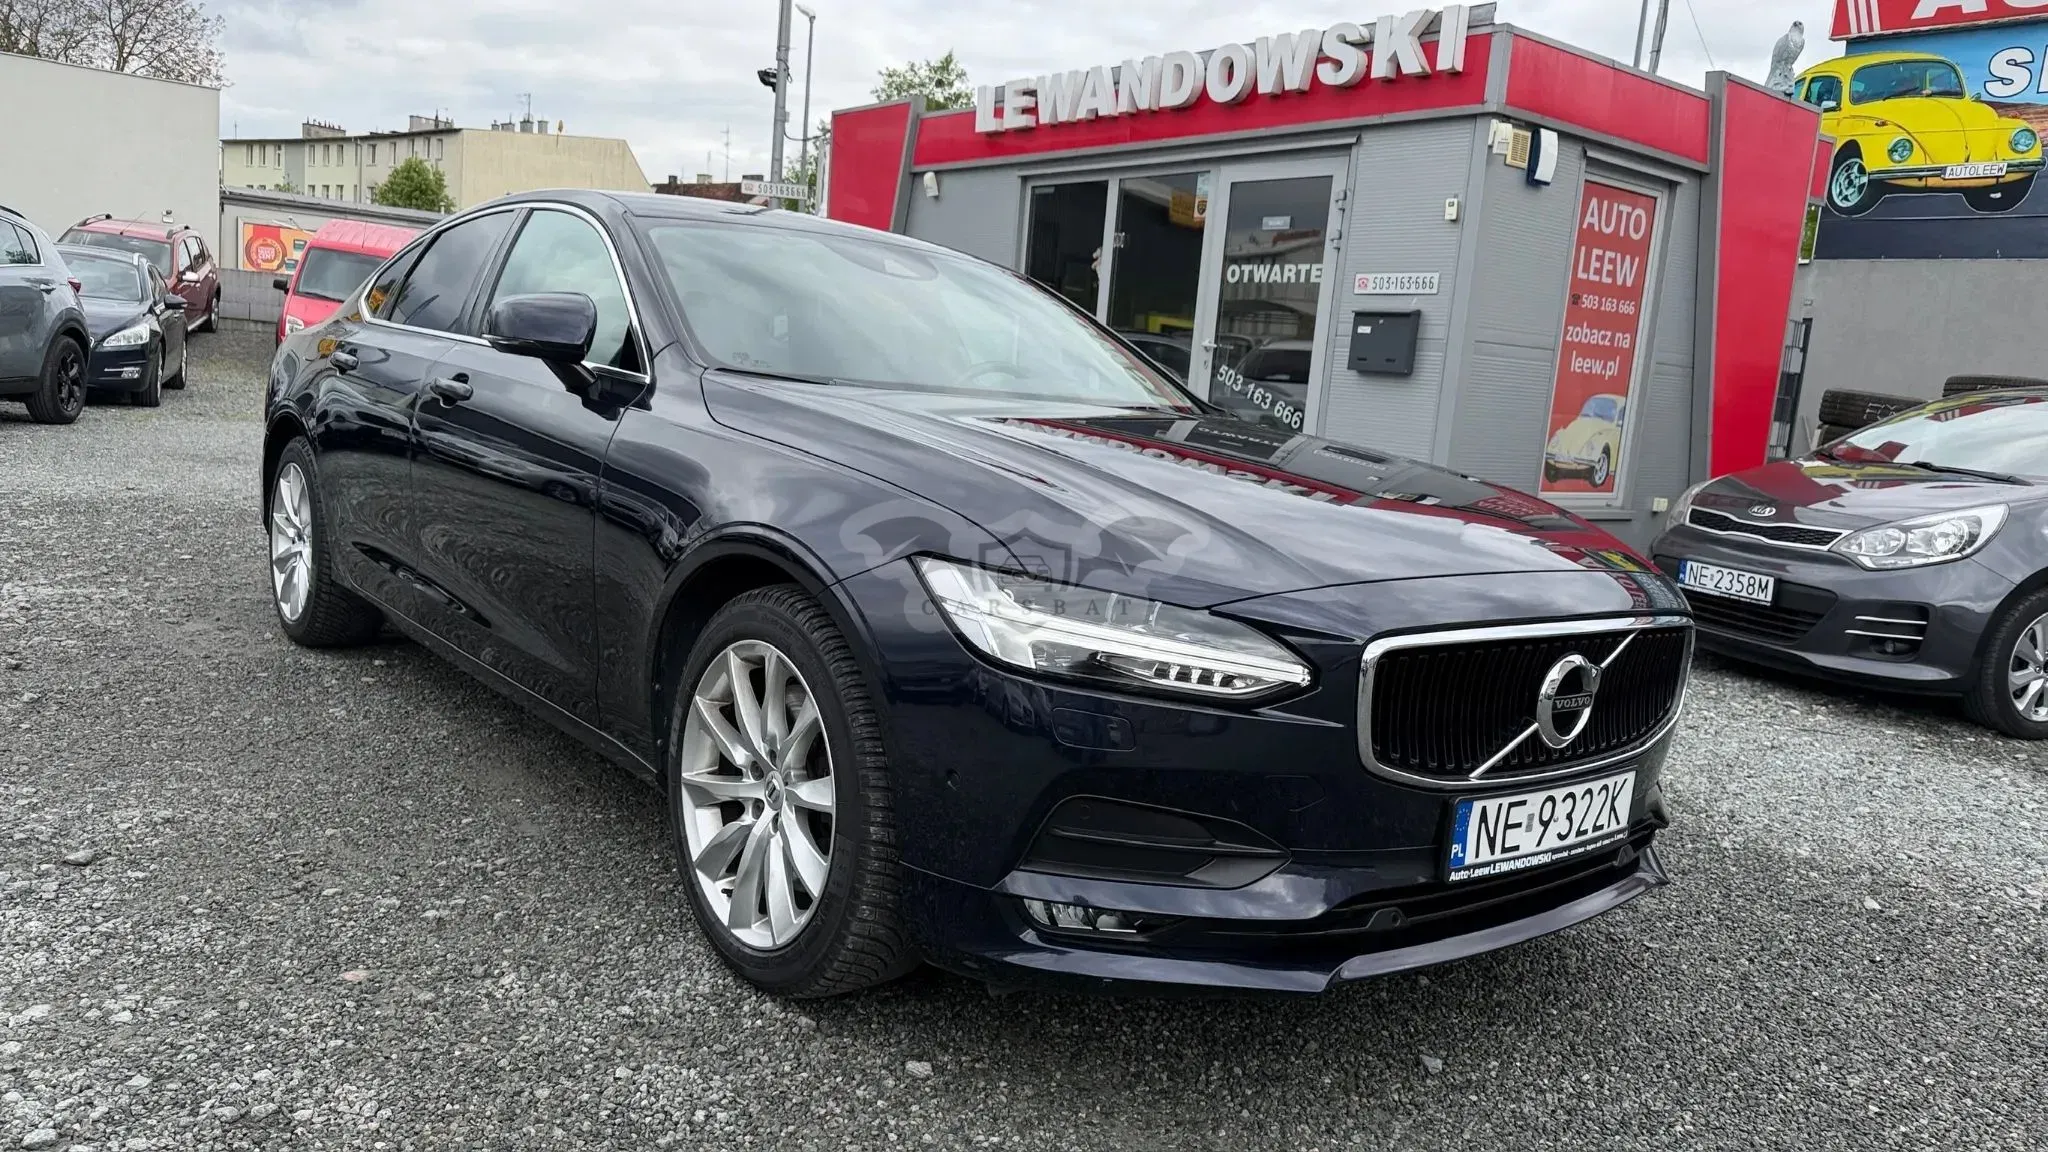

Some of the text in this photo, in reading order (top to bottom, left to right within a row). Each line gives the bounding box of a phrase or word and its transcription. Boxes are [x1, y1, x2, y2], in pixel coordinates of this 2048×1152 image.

[975, 4, 1467, 134] LEWANDOWSKI
[1984, 46, 2048, 99] S
[1949, 163, 2005, 178] AUTOLEEW
[1582, 196, 1647, 240] AUTO
[1226, 263, 1324, 284] OTWARTE
[1577, 245, 1640, 288] LEEW
[1581, 293, 1636, 316] 503 163 666
[1566, 320, 1632, 349] zobacz na
[1570, 349, 1620, 381] leew.pl
[1217, 364, 1303, 430] 503 163 666
[1689, 563, 1711, 587] NE
[1714, 569, 1770, 600] 2358M
[1555, 696, 1591, 709] VOLVO
[1475, 799, 1528, 860] NE
[1535, 778, 1629, 849] 9322K
[1451, 844, 1465, 860] PL
[1490, 852, 1552, 875] LEWANDOWSKI
